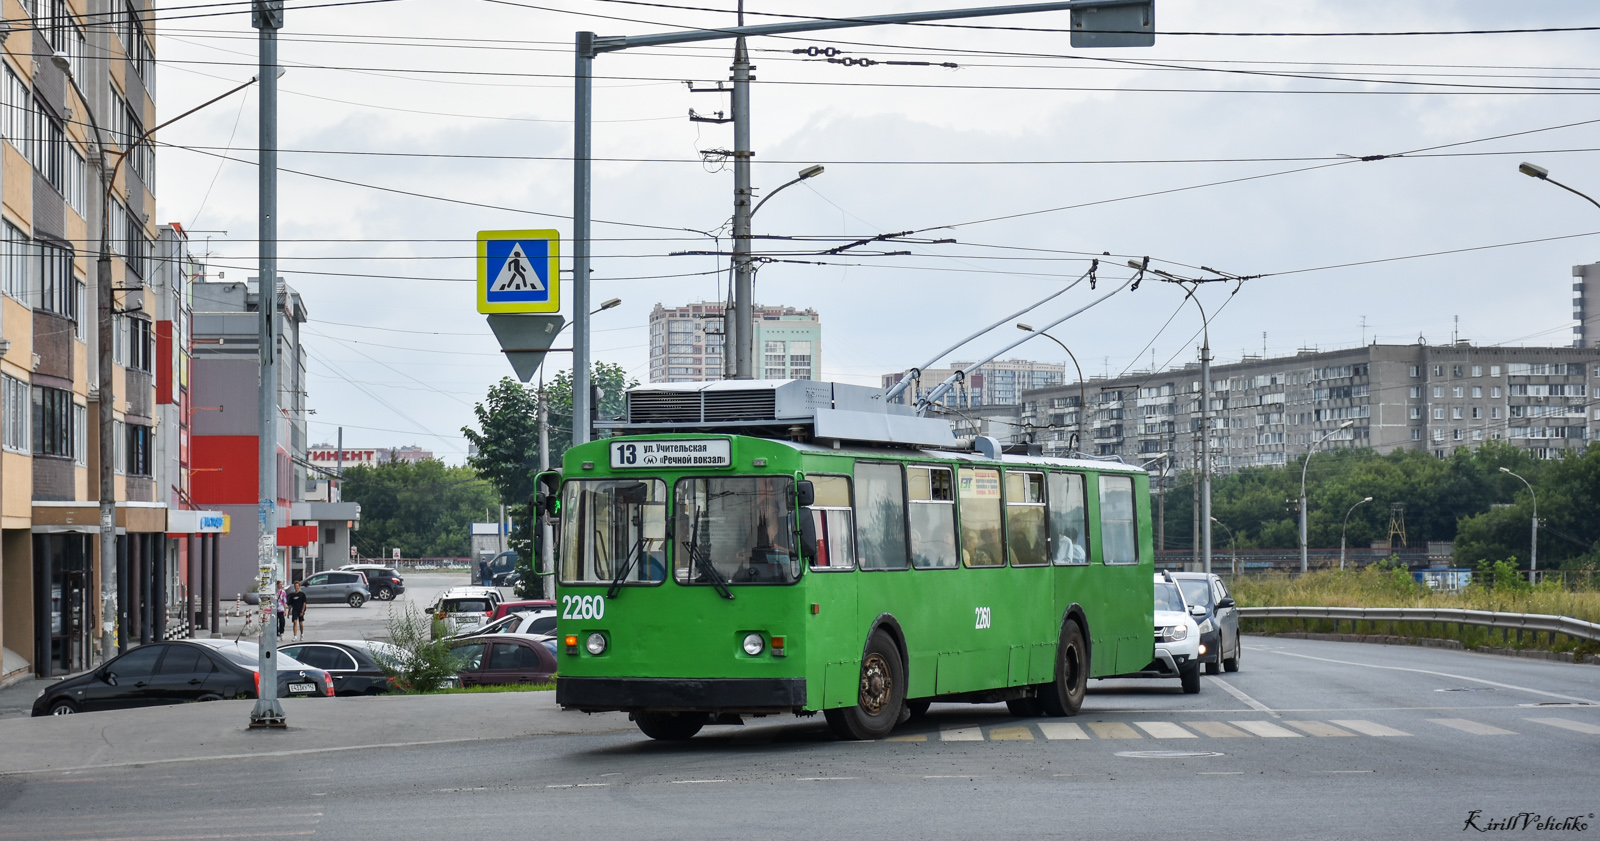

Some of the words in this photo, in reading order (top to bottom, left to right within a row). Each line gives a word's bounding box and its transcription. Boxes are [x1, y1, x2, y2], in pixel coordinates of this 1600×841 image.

[617, 444, 637, 464] 13
[643, 445, 655, 453] ул.
[656, 443, 707, 453] Учительская
[660, 455, 692, 464] «Речной
[693, 455, 726, 464] вокзал»
[562, 594, 605, 620] 2260
[975, 606, 991, 630] 2260
